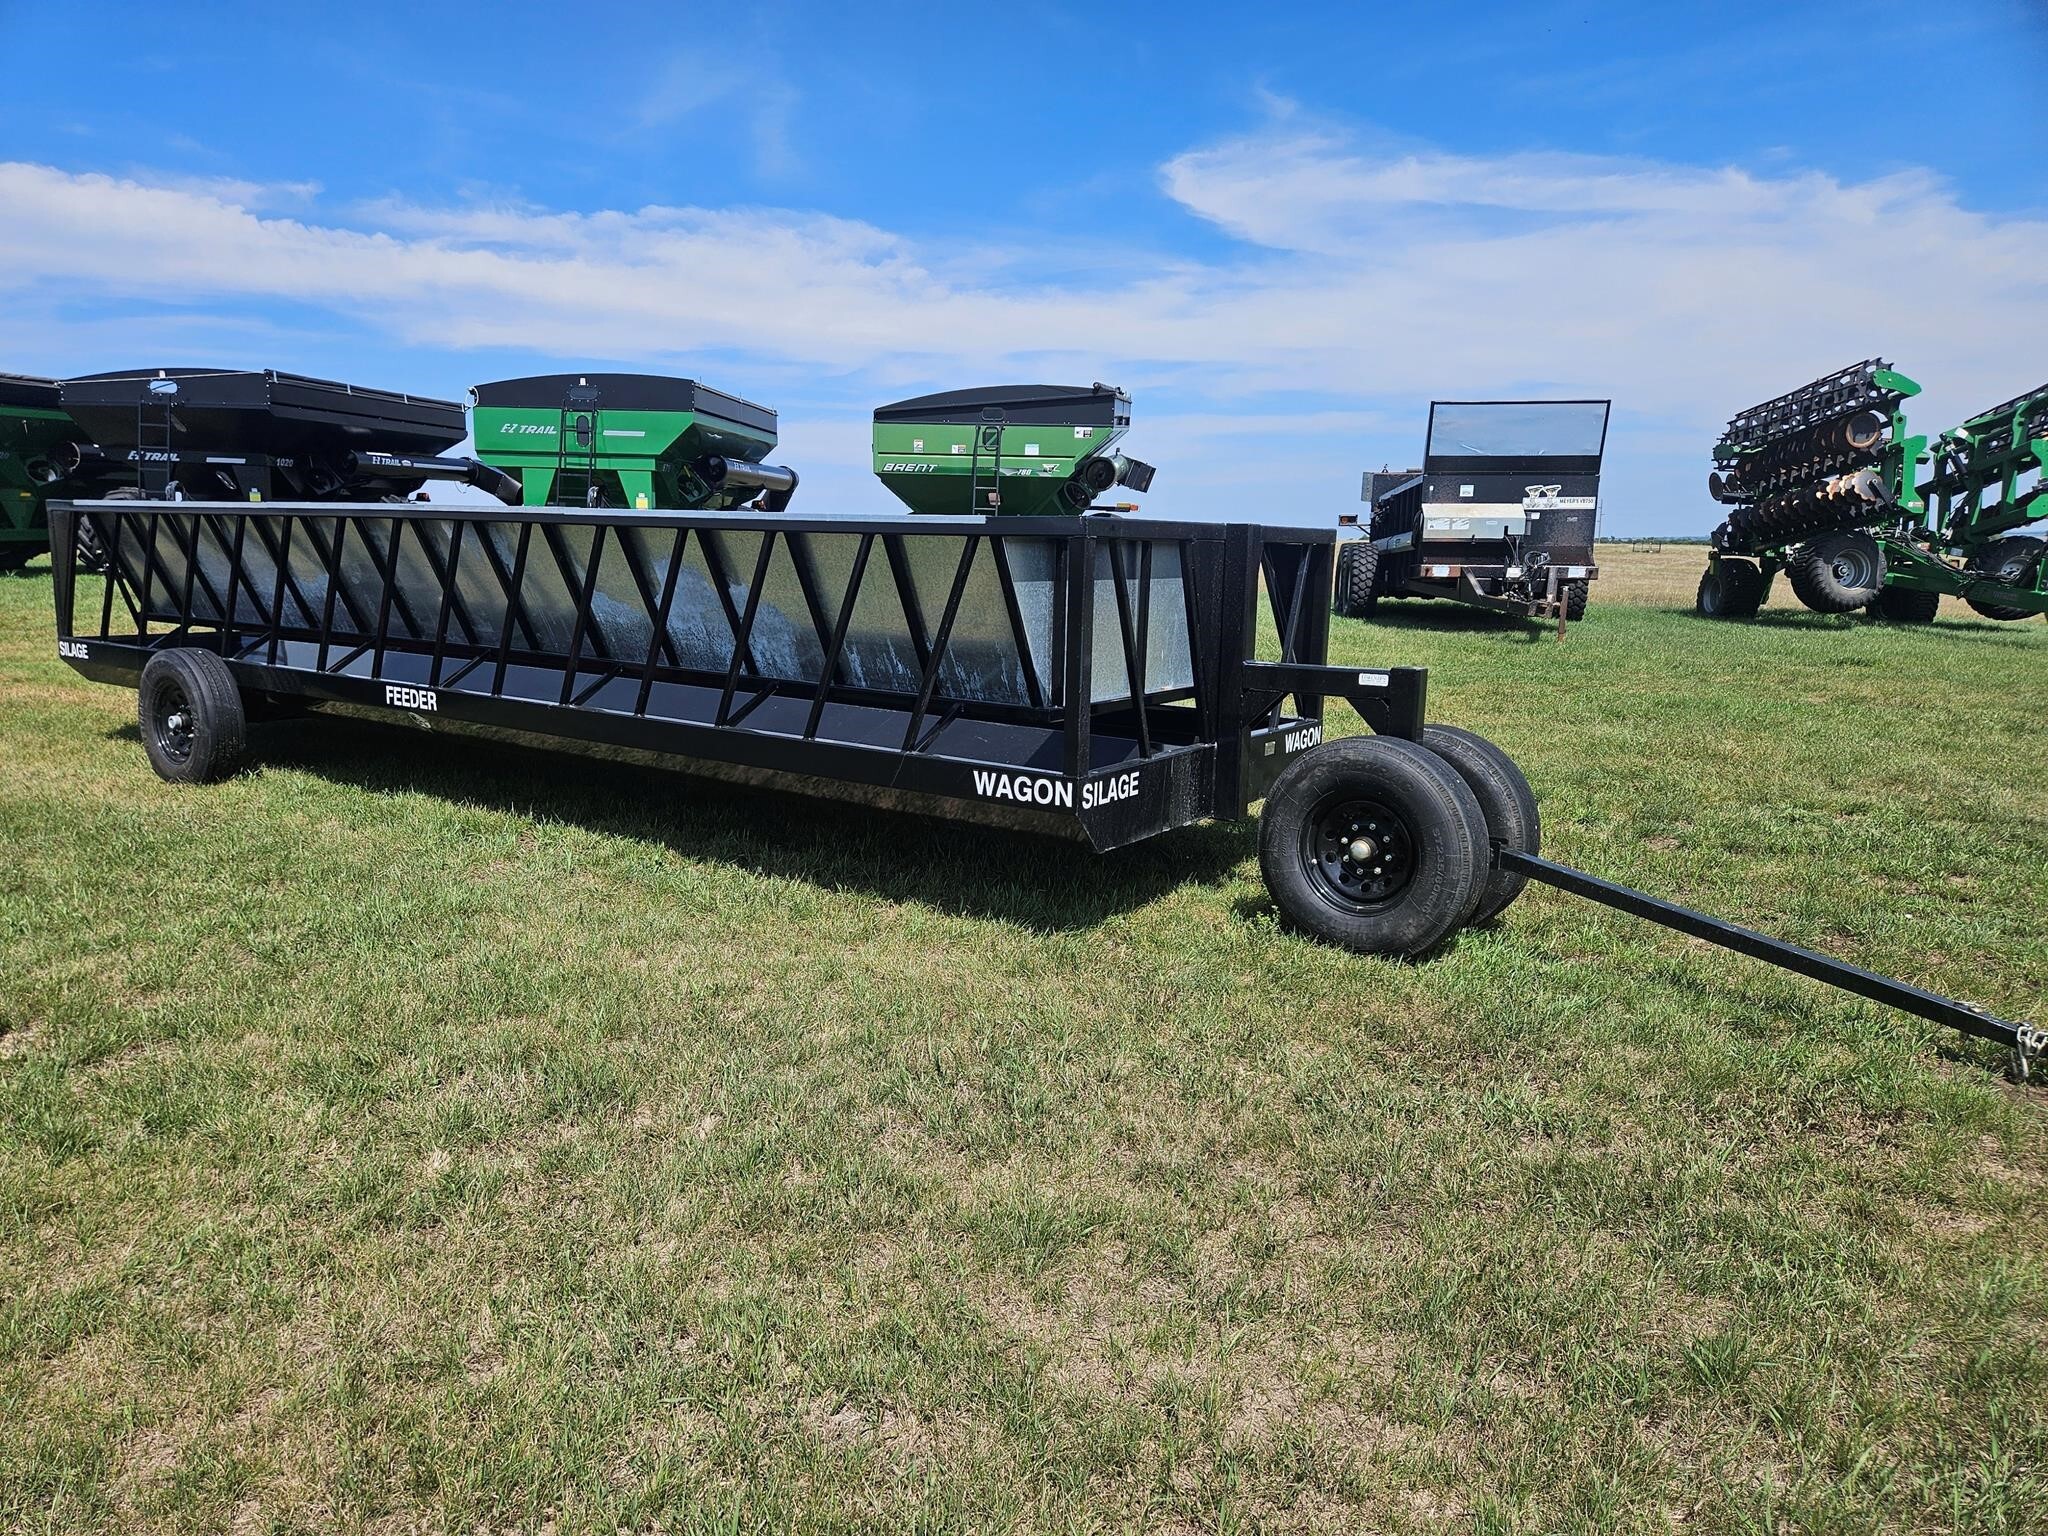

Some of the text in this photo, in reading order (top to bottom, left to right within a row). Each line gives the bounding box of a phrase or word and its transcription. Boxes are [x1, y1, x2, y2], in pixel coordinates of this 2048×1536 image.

[519, 425, 557, 434] TRAIL
[144, 452, 180, 461] TRAIL
[276, 457, 293, 467] 1020
[882, 463, 938, 472] BRENT
[59, 640, 89, 660] SILAGE
[385, 684, 438, 712] FEEDER
[1285, 725, 1322, 754] WAGON
[973, 770, 1073, 808] WAGON
[1082, 771, 1140, 810] SILAGE
